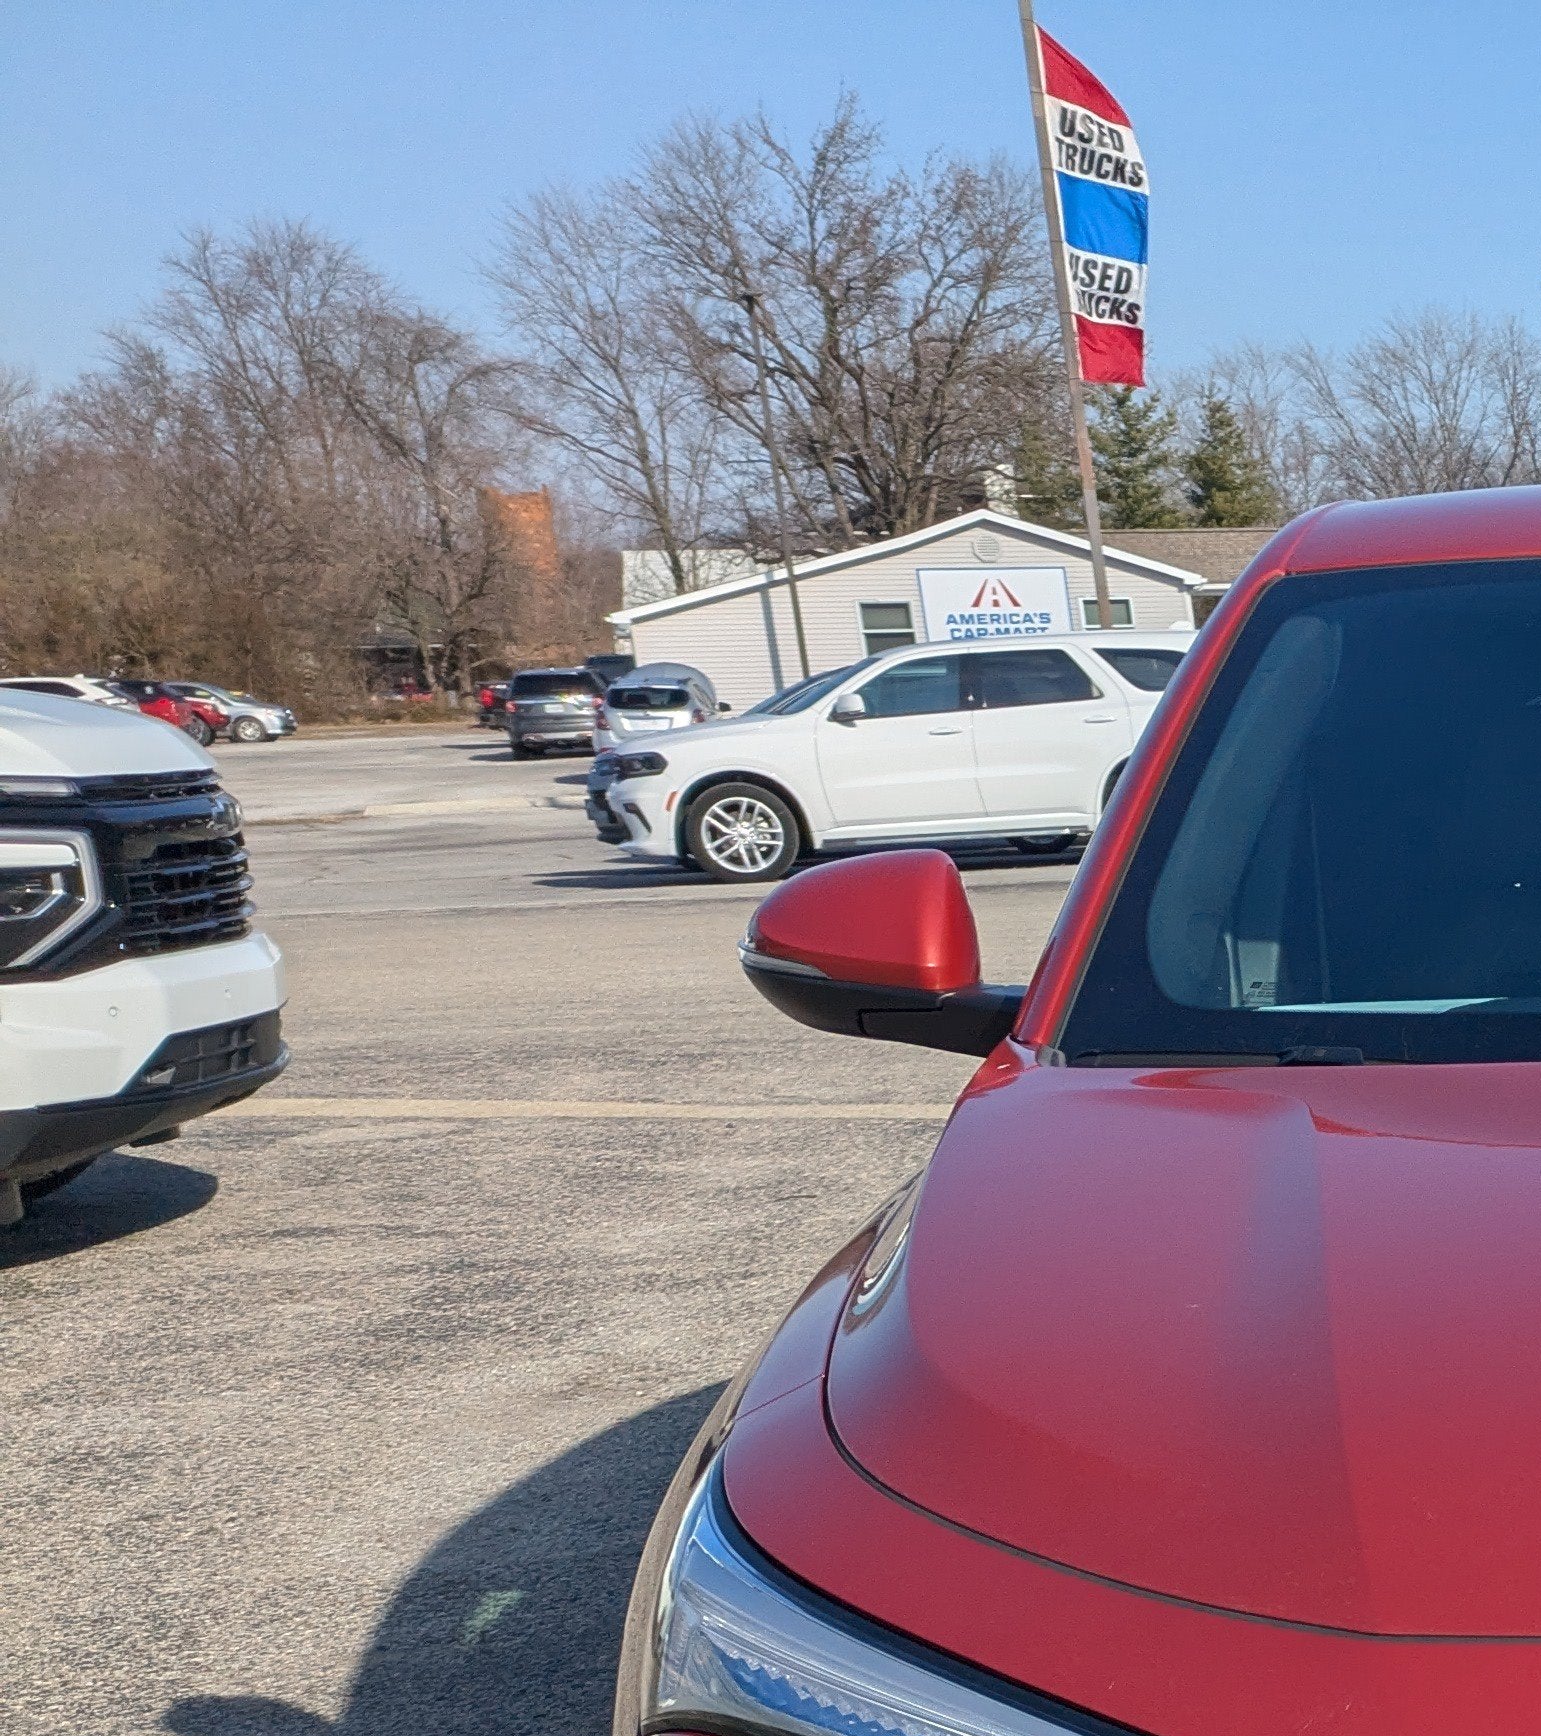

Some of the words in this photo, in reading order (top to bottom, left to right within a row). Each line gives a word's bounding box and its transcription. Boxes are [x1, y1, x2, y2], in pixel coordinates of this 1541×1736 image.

[1060, 106, 1124, 153] USED
[1055, 136, 1145, 187] TRUCKS
[1069, 252, 1133, 295] USED
[946, 612, 1051, 626] AMERICA'S
